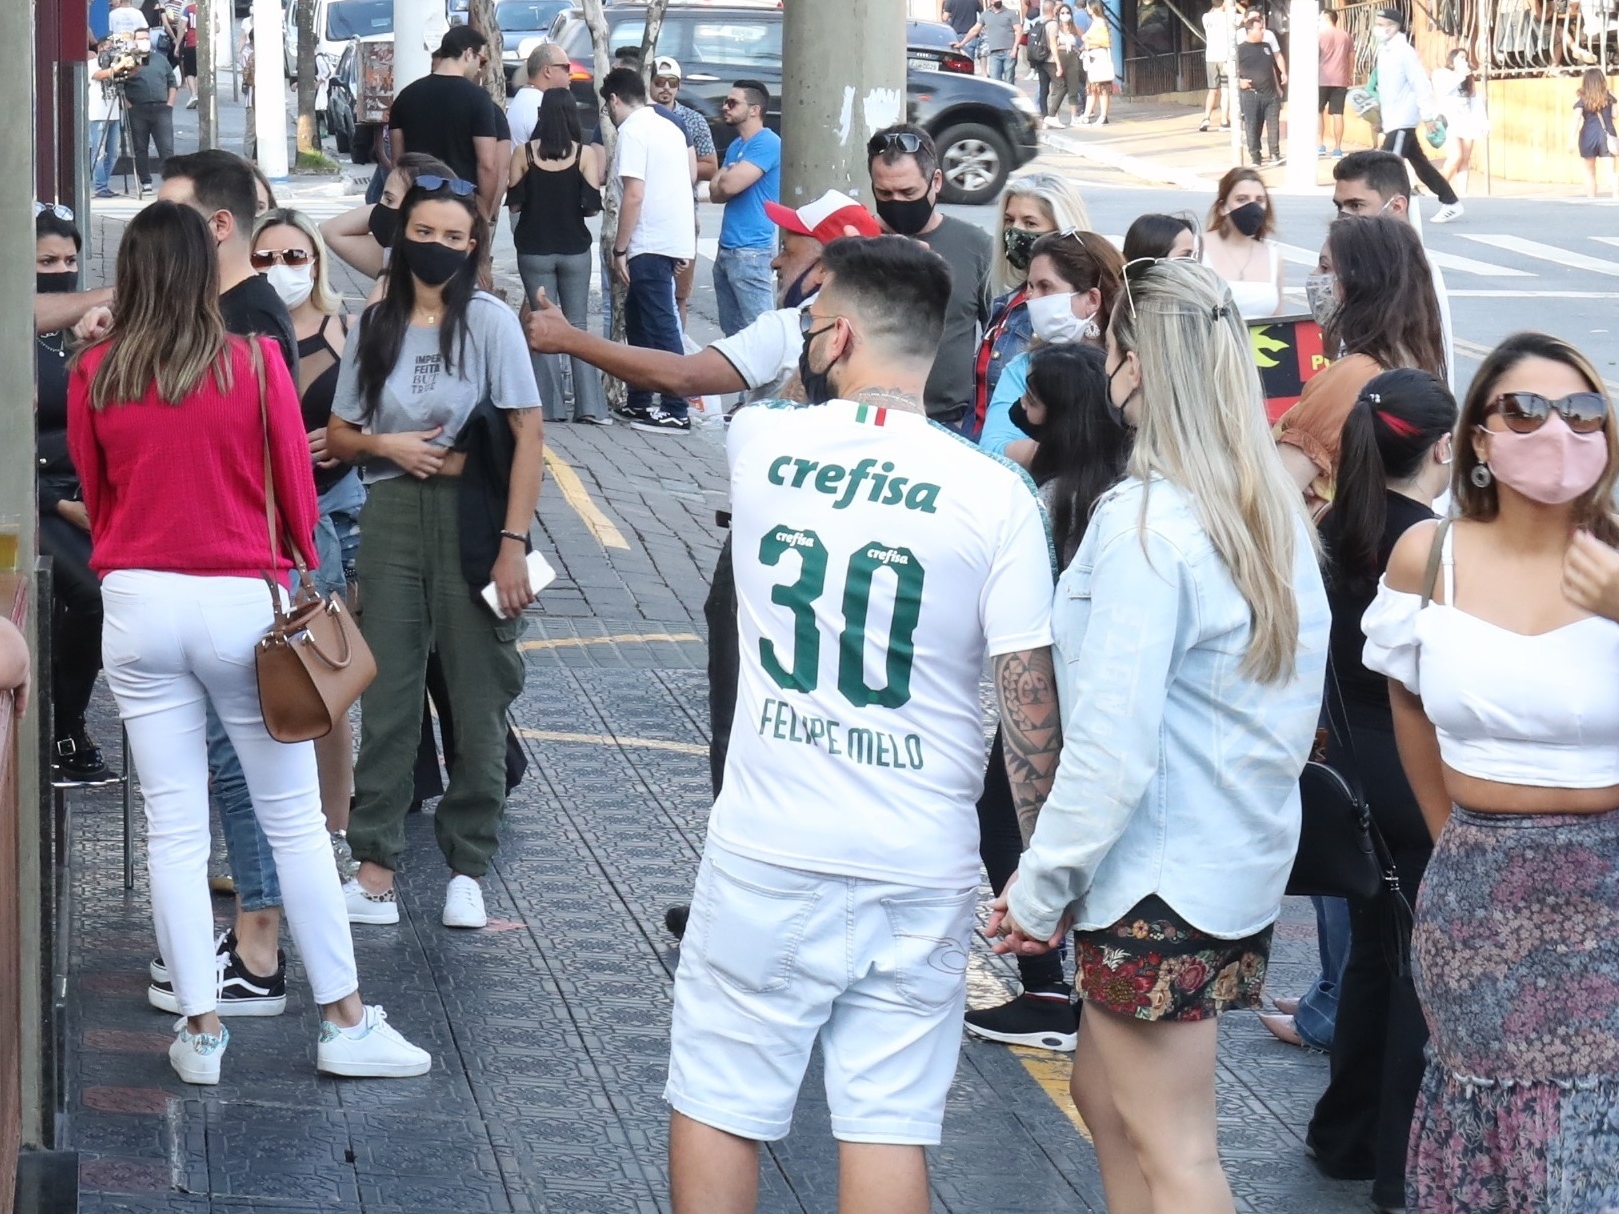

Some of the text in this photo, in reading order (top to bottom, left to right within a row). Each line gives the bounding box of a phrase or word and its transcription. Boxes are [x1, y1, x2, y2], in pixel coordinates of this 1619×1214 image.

[767, 455, 942, 514] crefisa
[775, 531, 815, 548] crefisa
[866, 548, 909, 564] crefisa
[758, 524, 925, 710] 30
[758, 697, 842, 757] FELIPE
[847, 726, 924, 771] MELO
